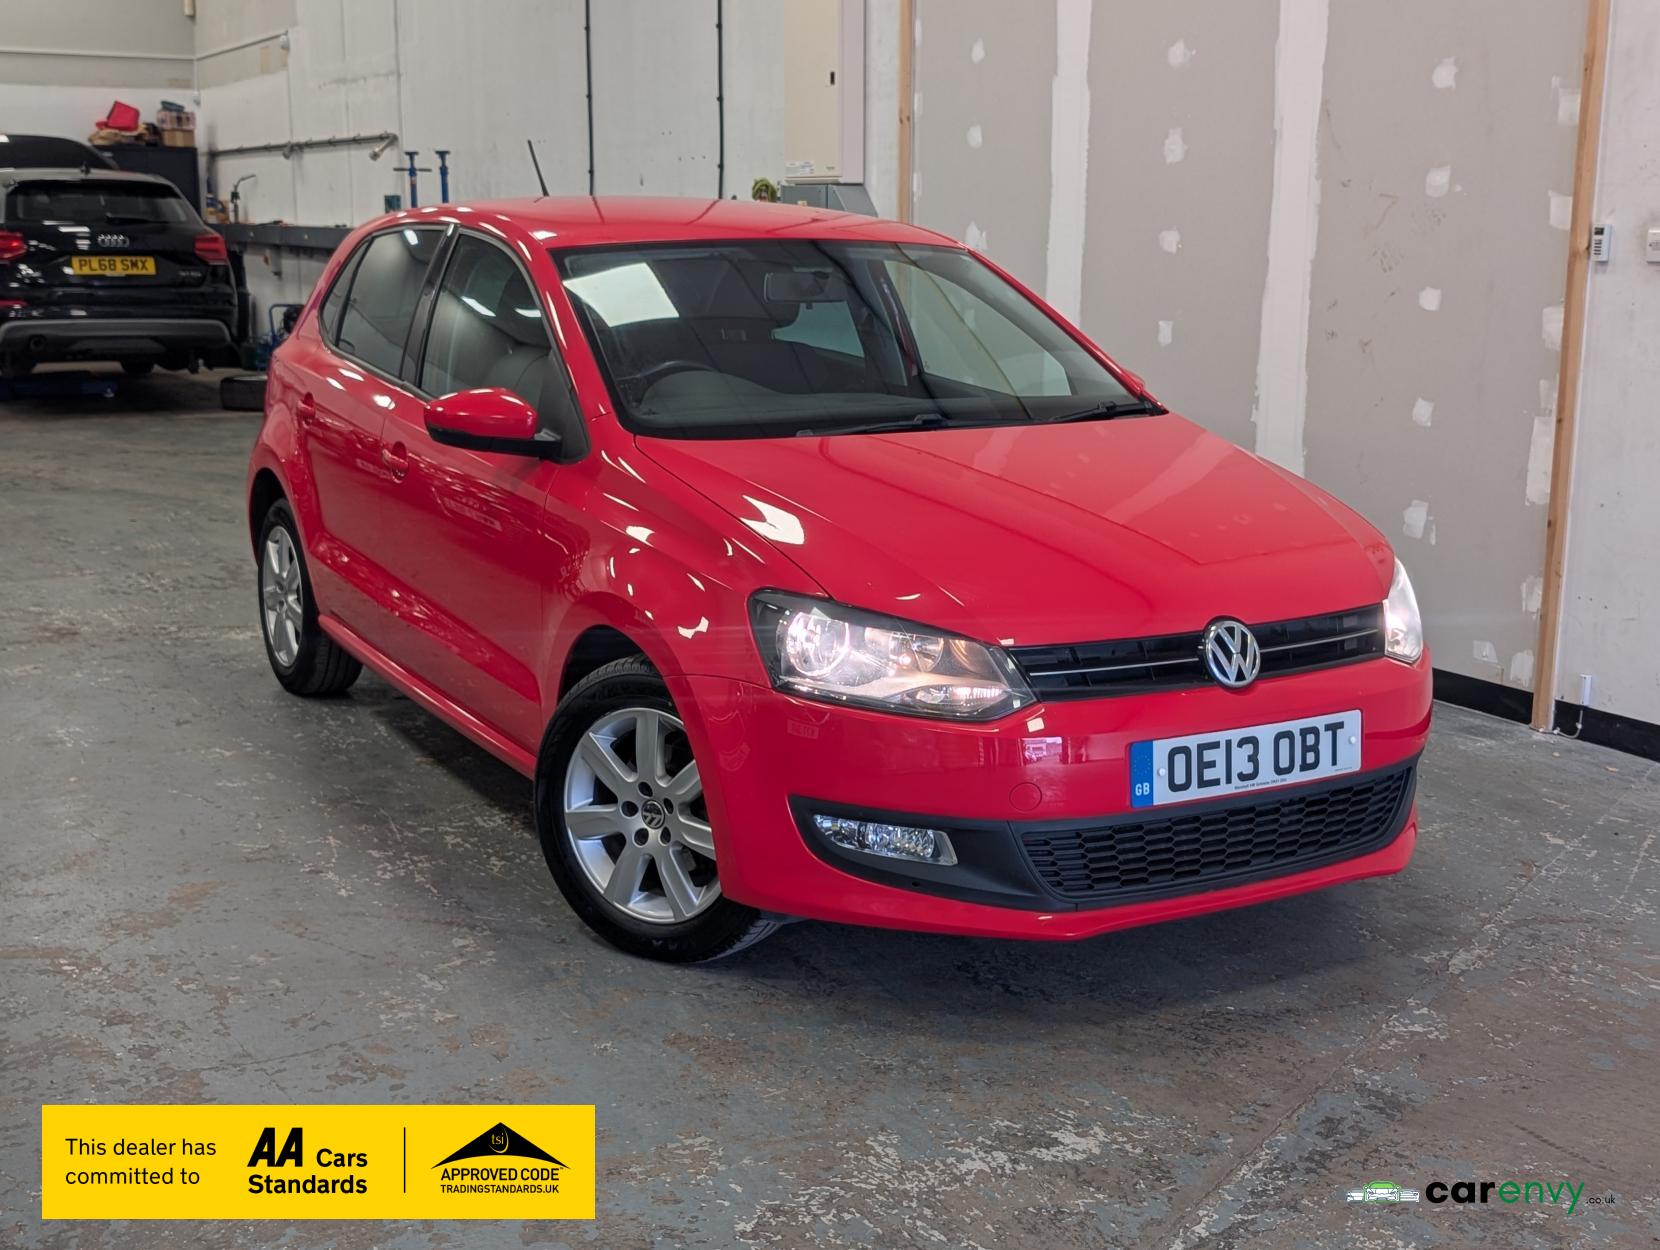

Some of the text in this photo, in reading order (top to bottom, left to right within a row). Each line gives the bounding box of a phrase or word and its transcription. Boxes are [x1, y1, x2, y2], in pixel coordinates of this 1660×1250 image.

[78, 258, 149, 272] PL68 SMX
[1167, 720, 1345, 793] OE13 OBT
[1135, 782, 1150, 796] GB
